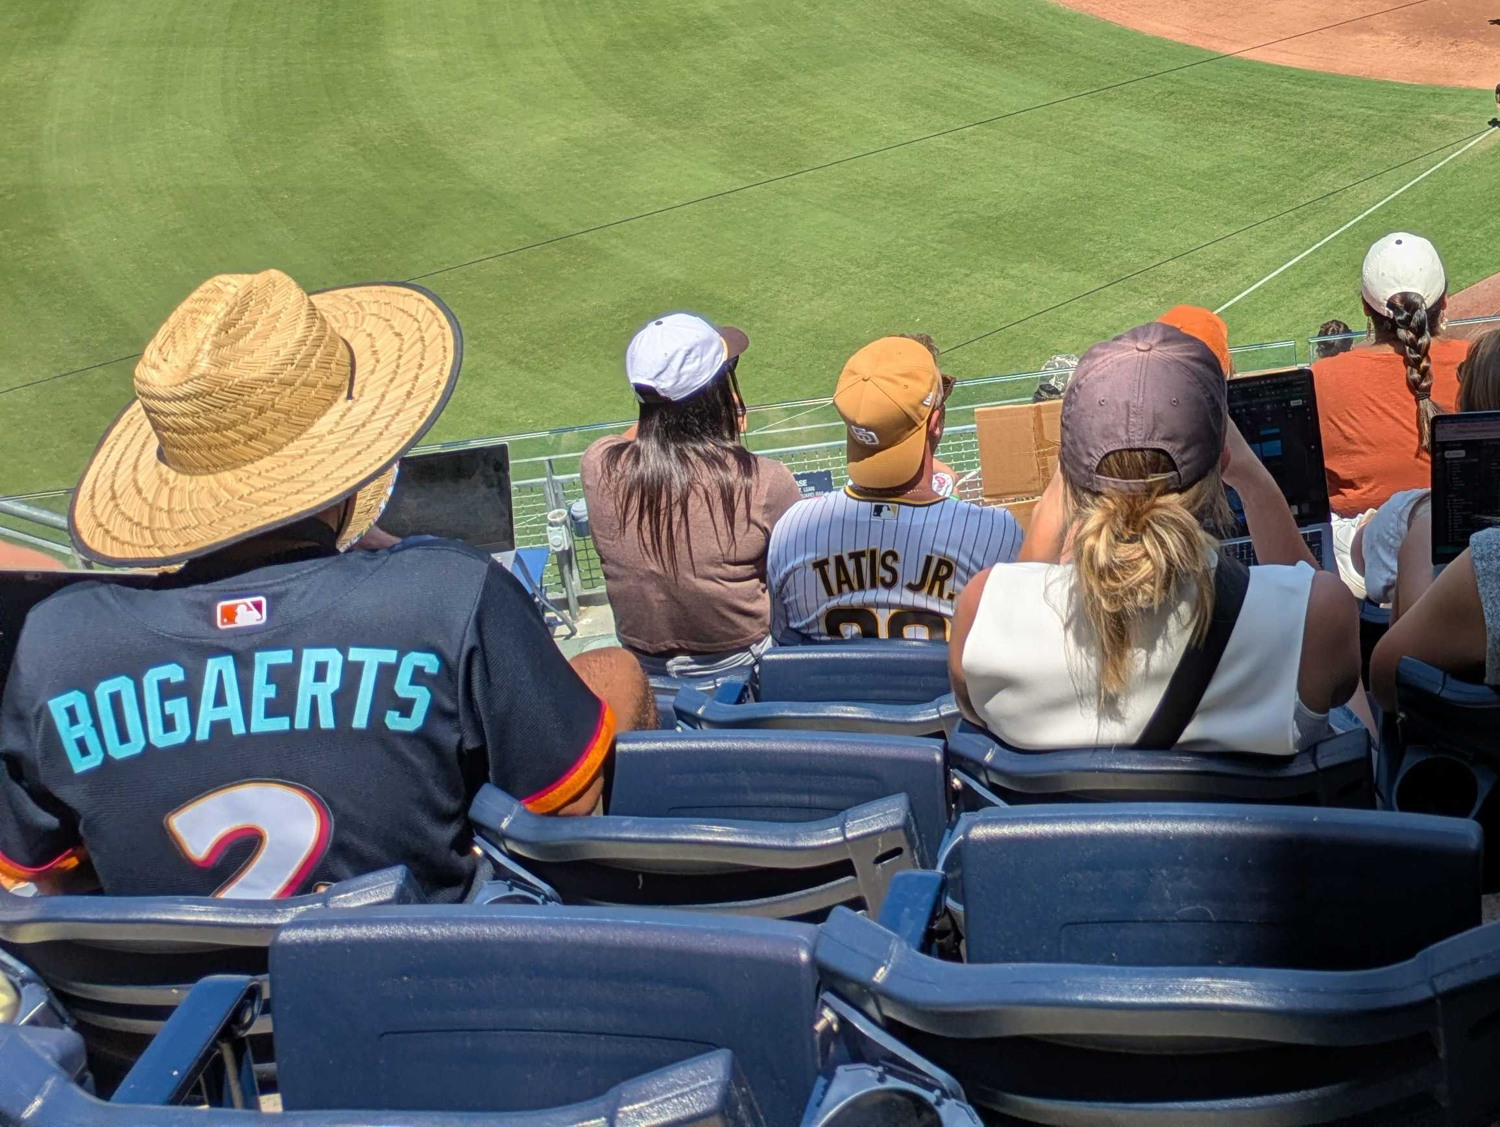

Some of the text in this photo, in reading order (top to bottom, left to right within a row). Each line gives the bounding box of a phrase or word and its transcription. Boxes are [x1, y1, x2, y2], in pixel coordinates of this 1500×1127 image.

[811, 547, 957, 601] TATIS JR.
[46, 644, 443, 774] BOGAERTS
[166, 779, 336, 900] 2
